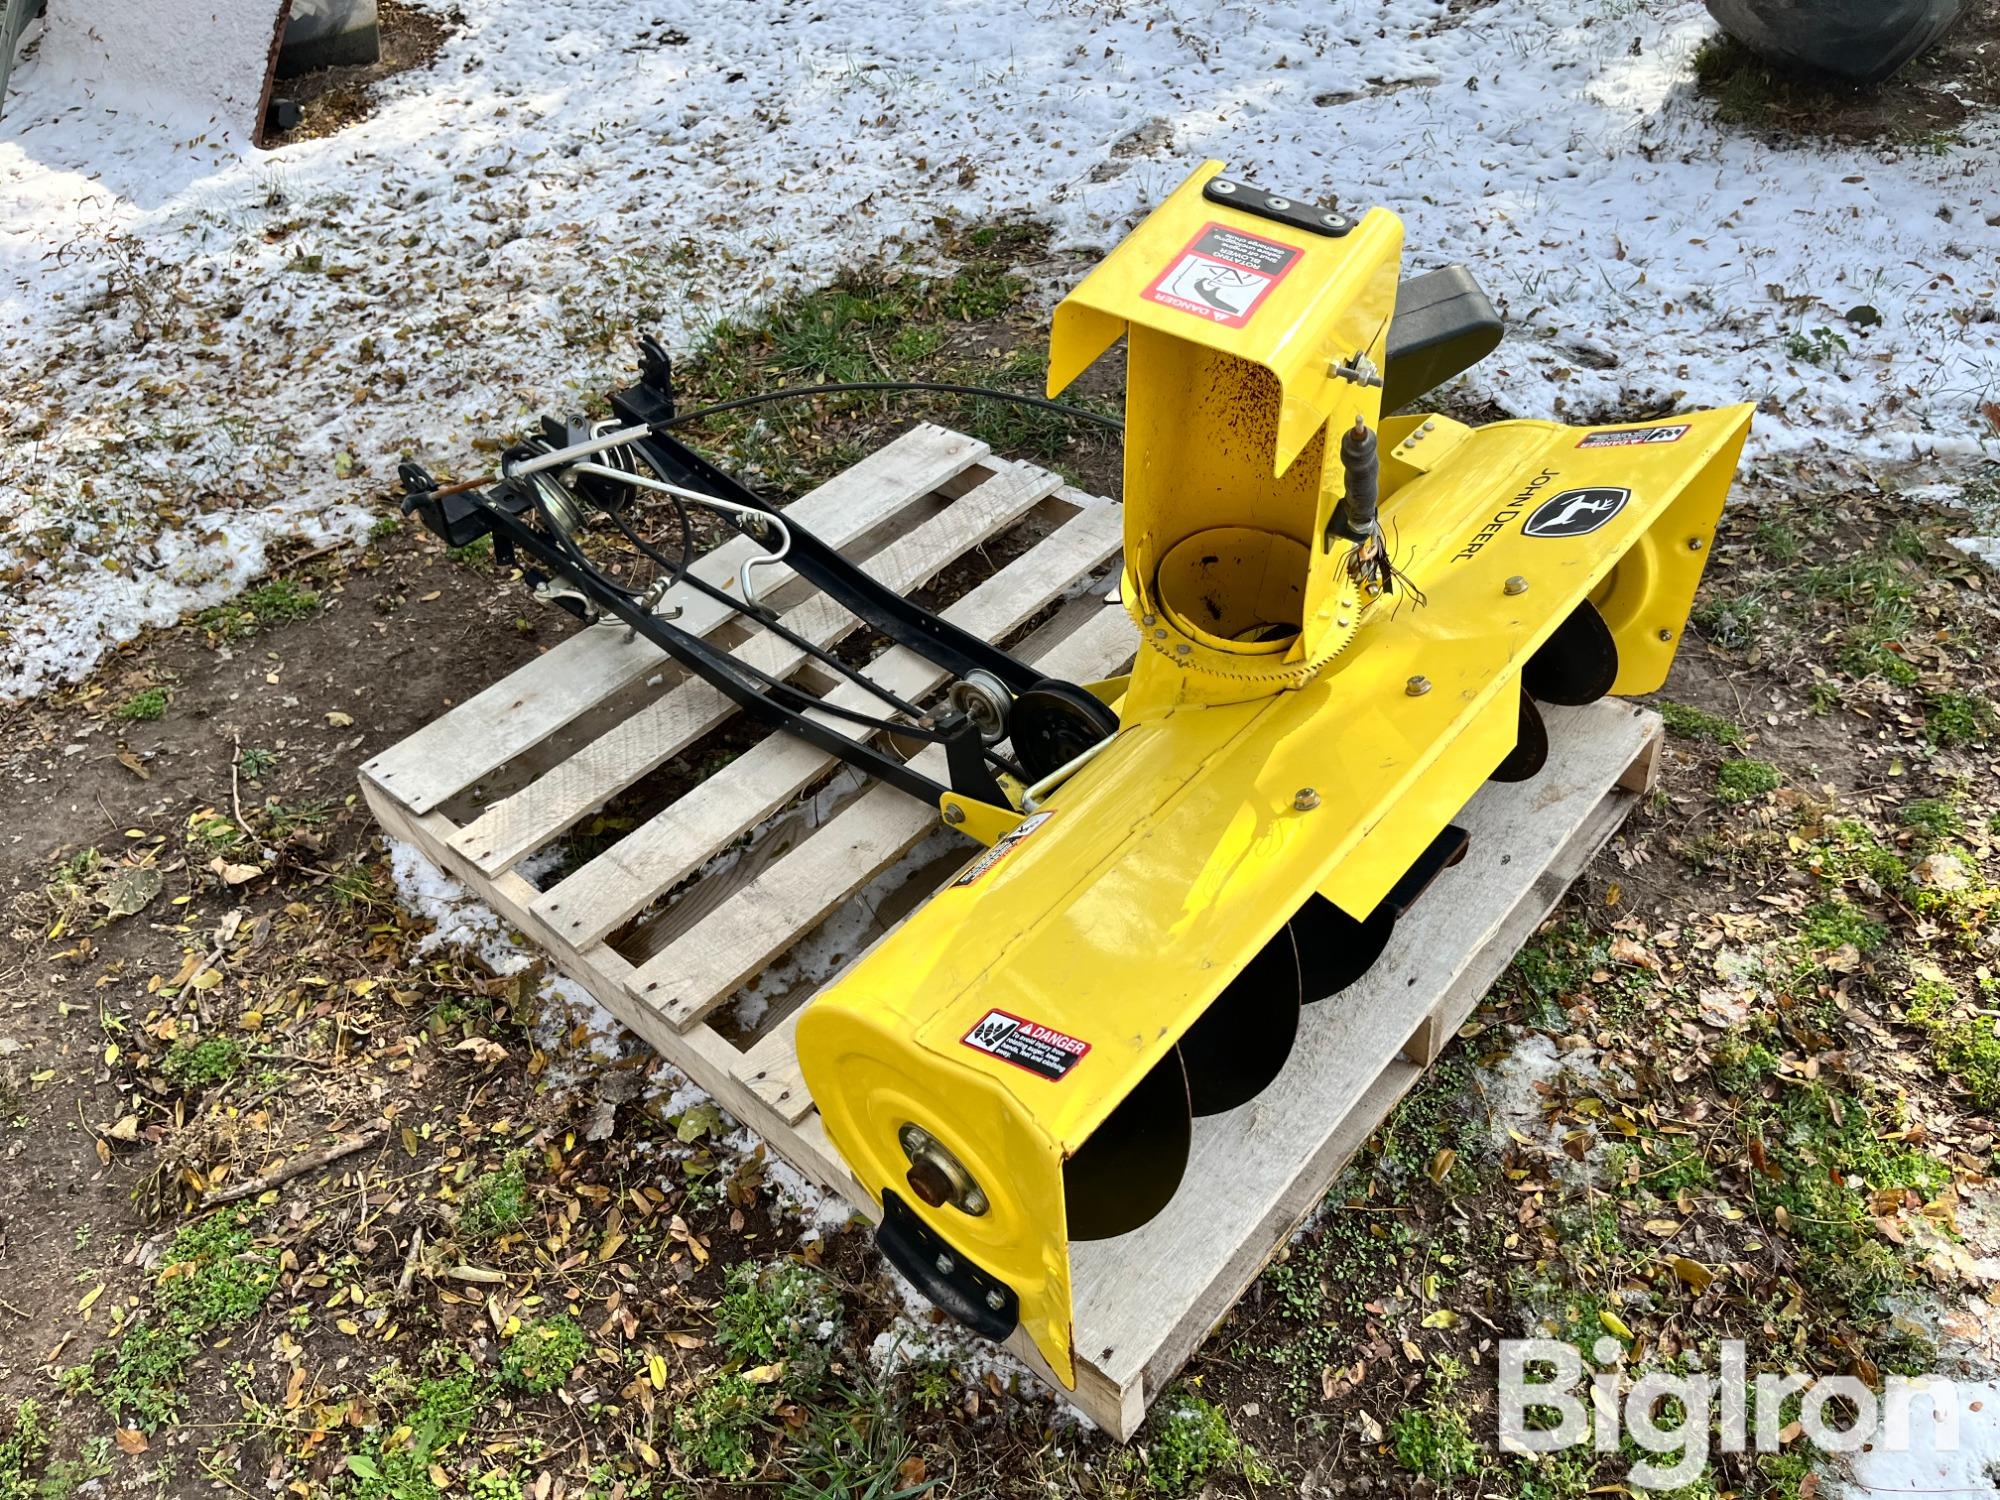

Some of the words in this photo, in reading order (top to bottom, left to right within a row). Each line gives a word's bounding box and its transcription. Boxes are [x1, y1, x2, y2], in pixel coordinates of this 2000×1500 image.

[1214, 235, 1257, 251] unclogging
[1221, 242, 1247, 253] engine
[1213, 251, 1260, 269] ROTATING
[1220, 248, 1261, 263] BLOWER
[1246, 249, 1259, 257] off
[1257, 247, 1280, 259] before
[1259, 253, 1278, 263] Shut
[1153, 293, 1210, 315] DANGER
[1508, 468, 1560, 507] JOHN
[1032, 1027, 1085, 1054] DANGER
